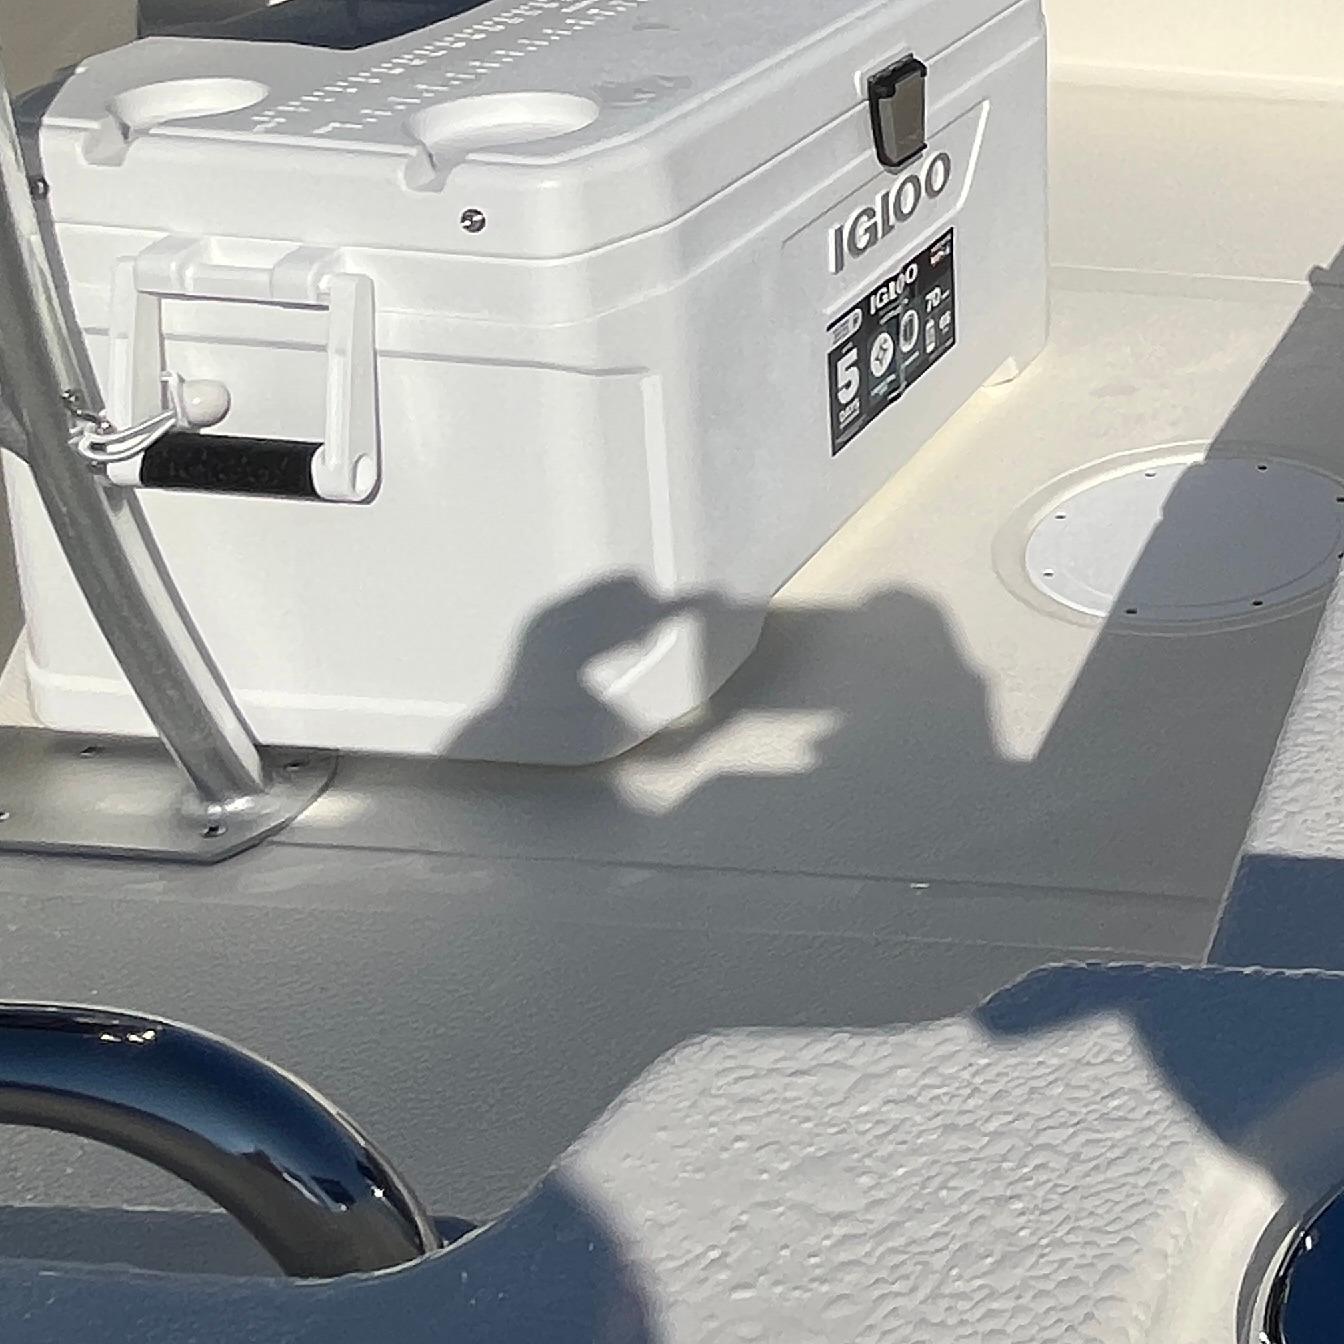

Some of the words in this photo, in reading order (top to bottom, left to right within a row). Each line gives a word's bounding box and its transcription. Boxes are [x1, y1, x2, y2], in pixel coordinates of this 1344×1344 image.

[829, 152, 951, 275] IGLOO
[869, 263, 918, 315] IGLOO
[836, 347, 860, 404] 5
